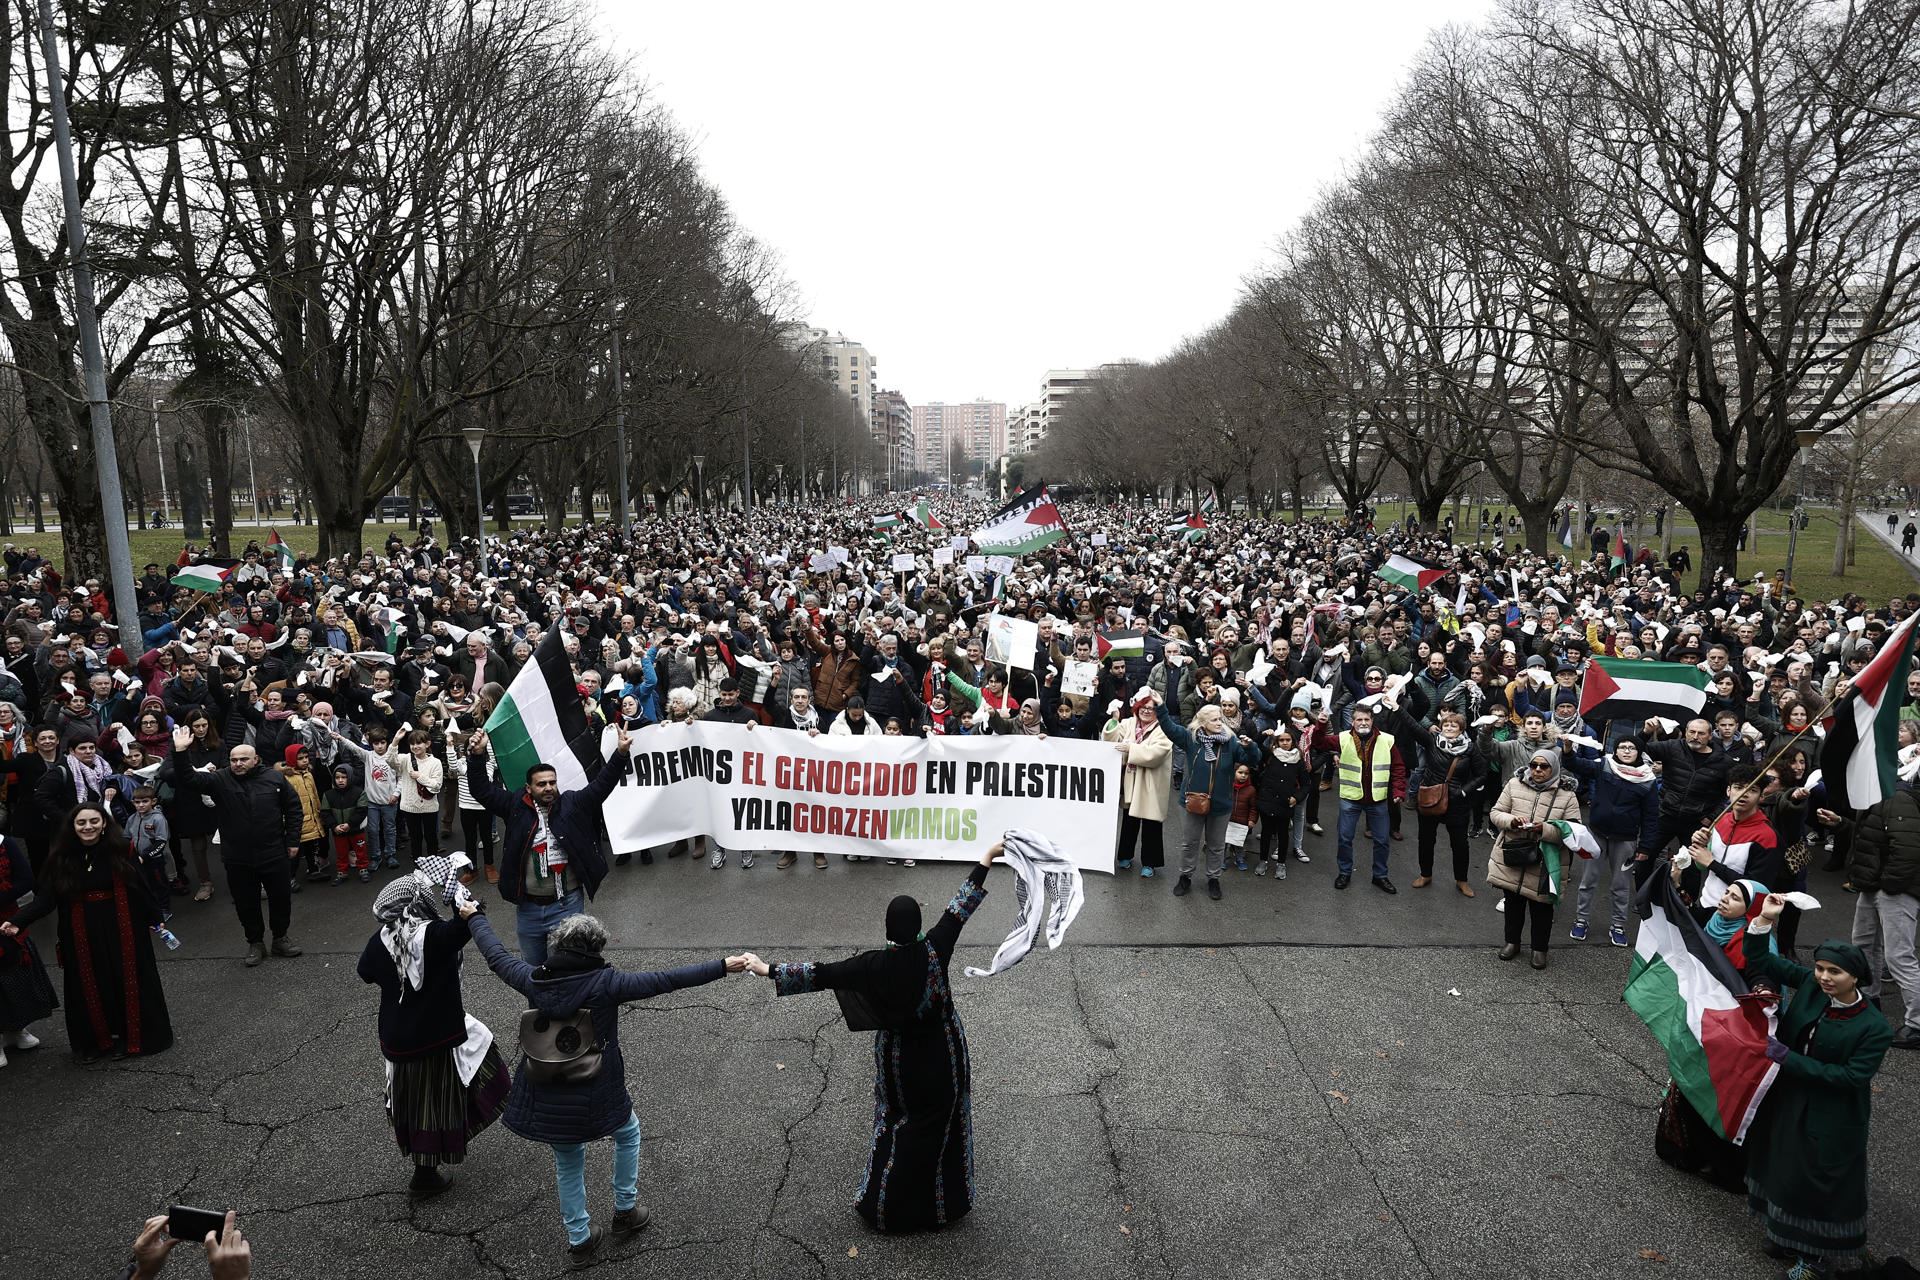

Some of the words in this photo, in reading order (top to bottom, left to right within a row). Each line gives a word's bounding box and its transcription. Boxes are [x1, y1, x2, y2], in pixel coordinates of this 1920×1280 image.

[619, 745, 733, 787] PAREMOS
[742, 751, 767, 787] EL
[775, 755, 918, 797] GENOCIDIO
[926, 761, 957, 795] EN
[966, 761, 1105, 804] PALESTINA
